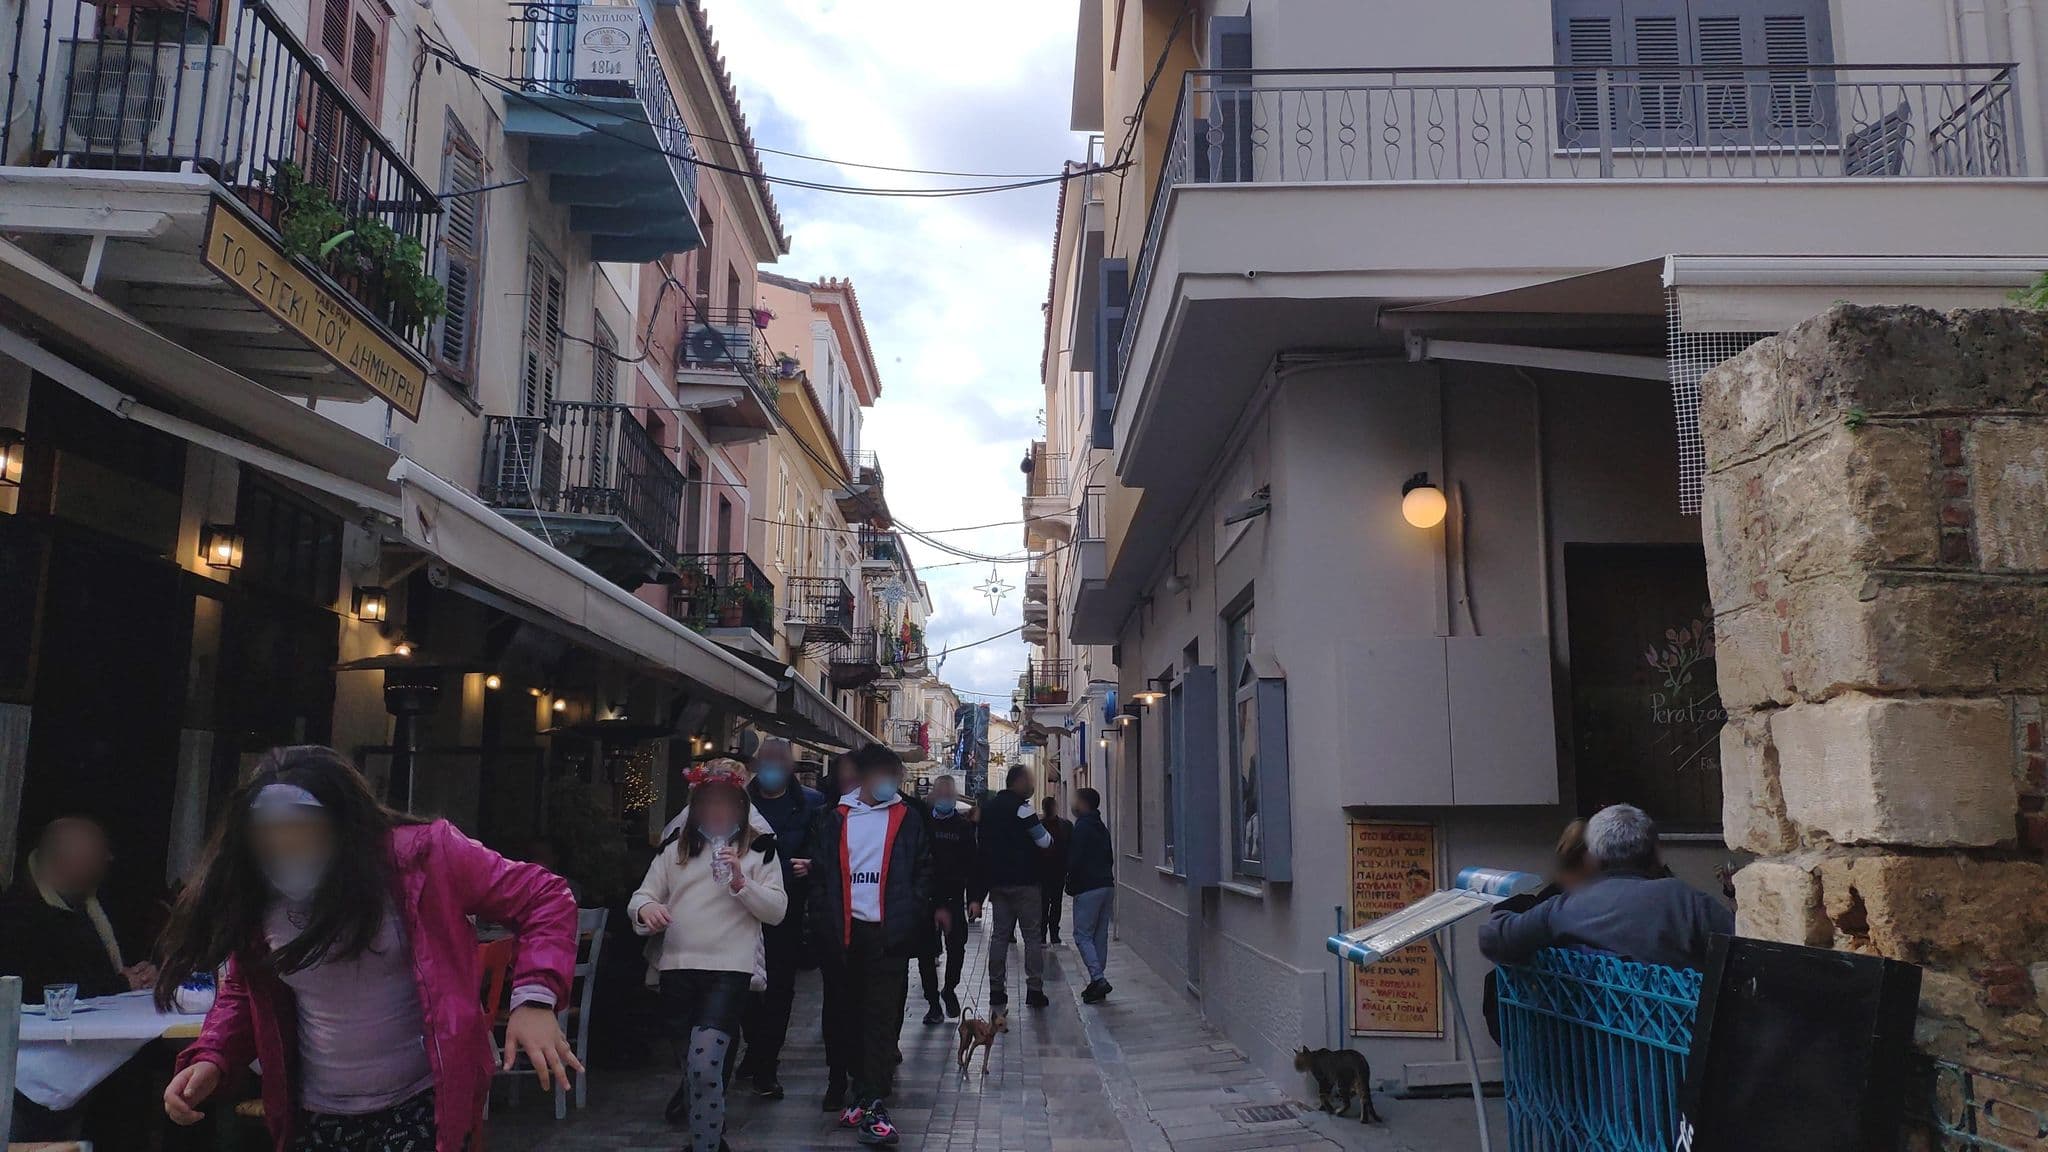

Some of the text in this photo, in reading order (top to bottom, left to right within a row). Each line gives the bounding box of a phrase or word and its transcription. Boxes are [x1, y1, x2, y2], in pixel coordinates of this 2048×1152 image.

[221, 232, 417, 408] ΤΟ ΣΤΕΚΙ ΤΟΥ ΔΗΜΗΤΡΗ
[314, 287, 351, 327] ΤΑΒΕΡΝΑ
[850, 871, 880, 884] IGIN
